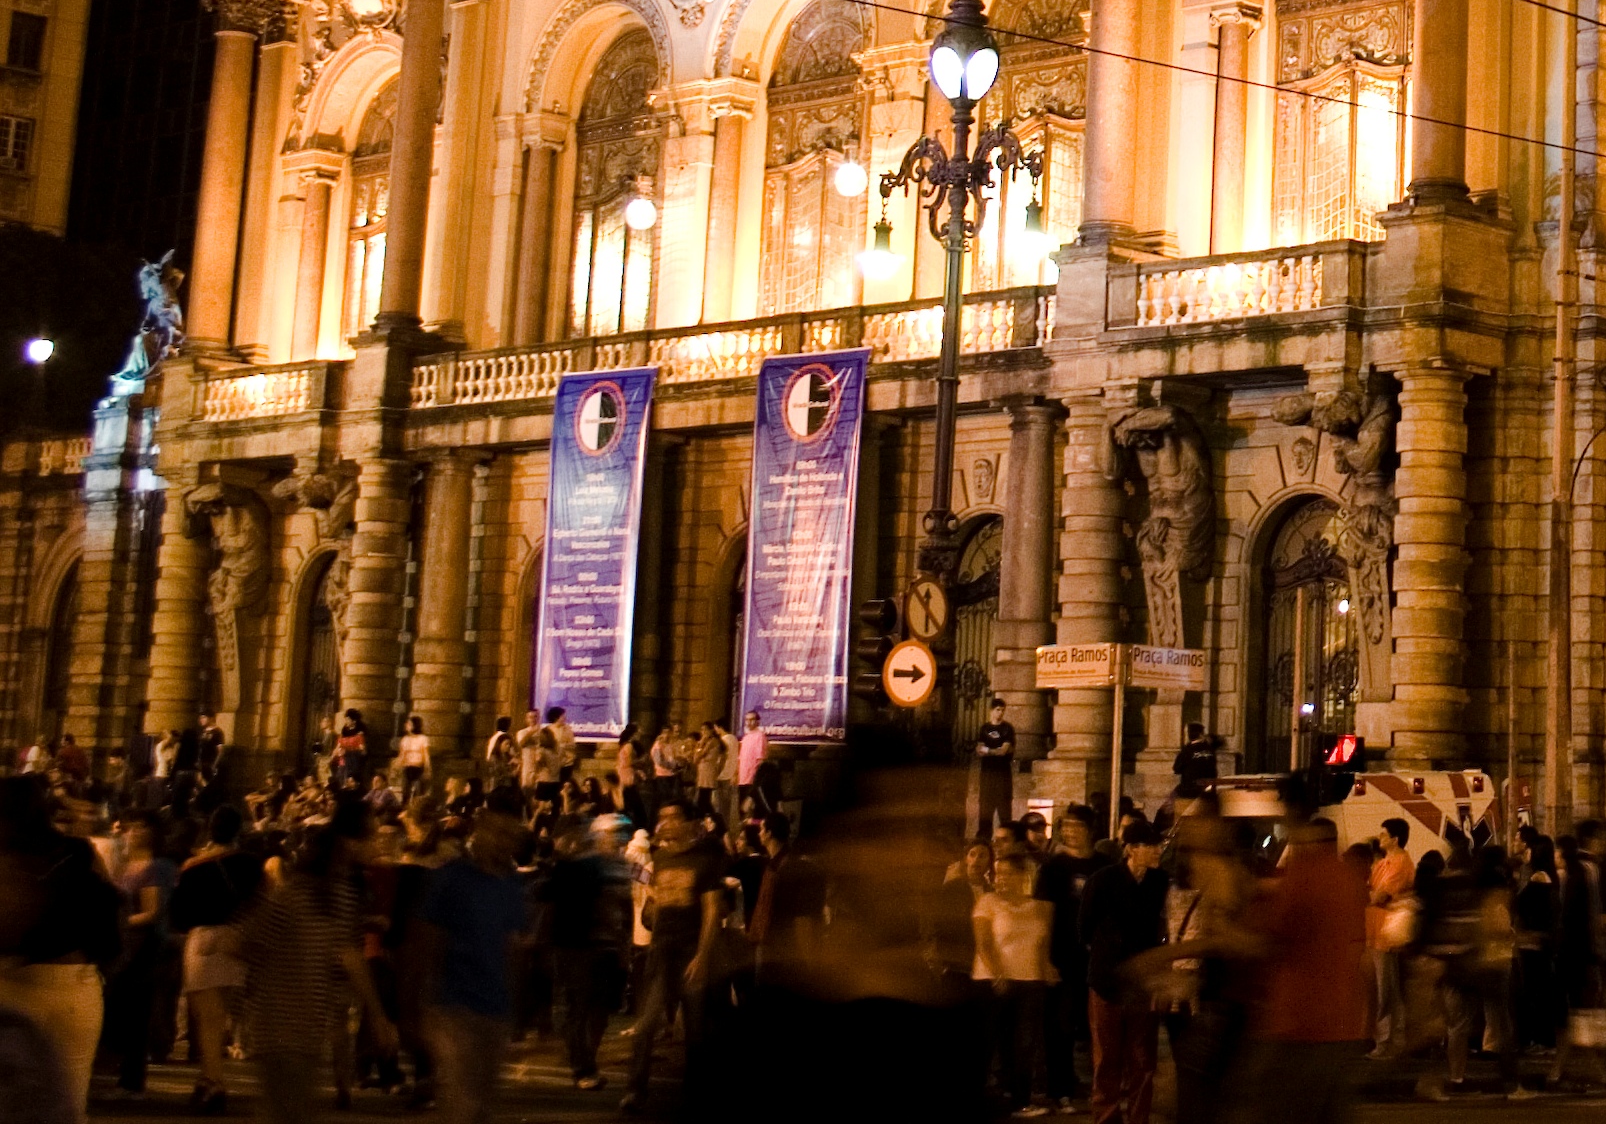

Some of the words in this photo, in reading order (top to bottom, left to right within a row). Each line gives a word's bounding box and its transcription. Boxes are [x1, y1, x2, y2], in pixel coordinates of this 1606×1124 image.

[1037, 649, 1067, 667] Praça
[1071, 646, 1108, 663] Ramos
[1133, 646, 1163, 667] Praça
[1166, 650, 1204, 667] Ramos
